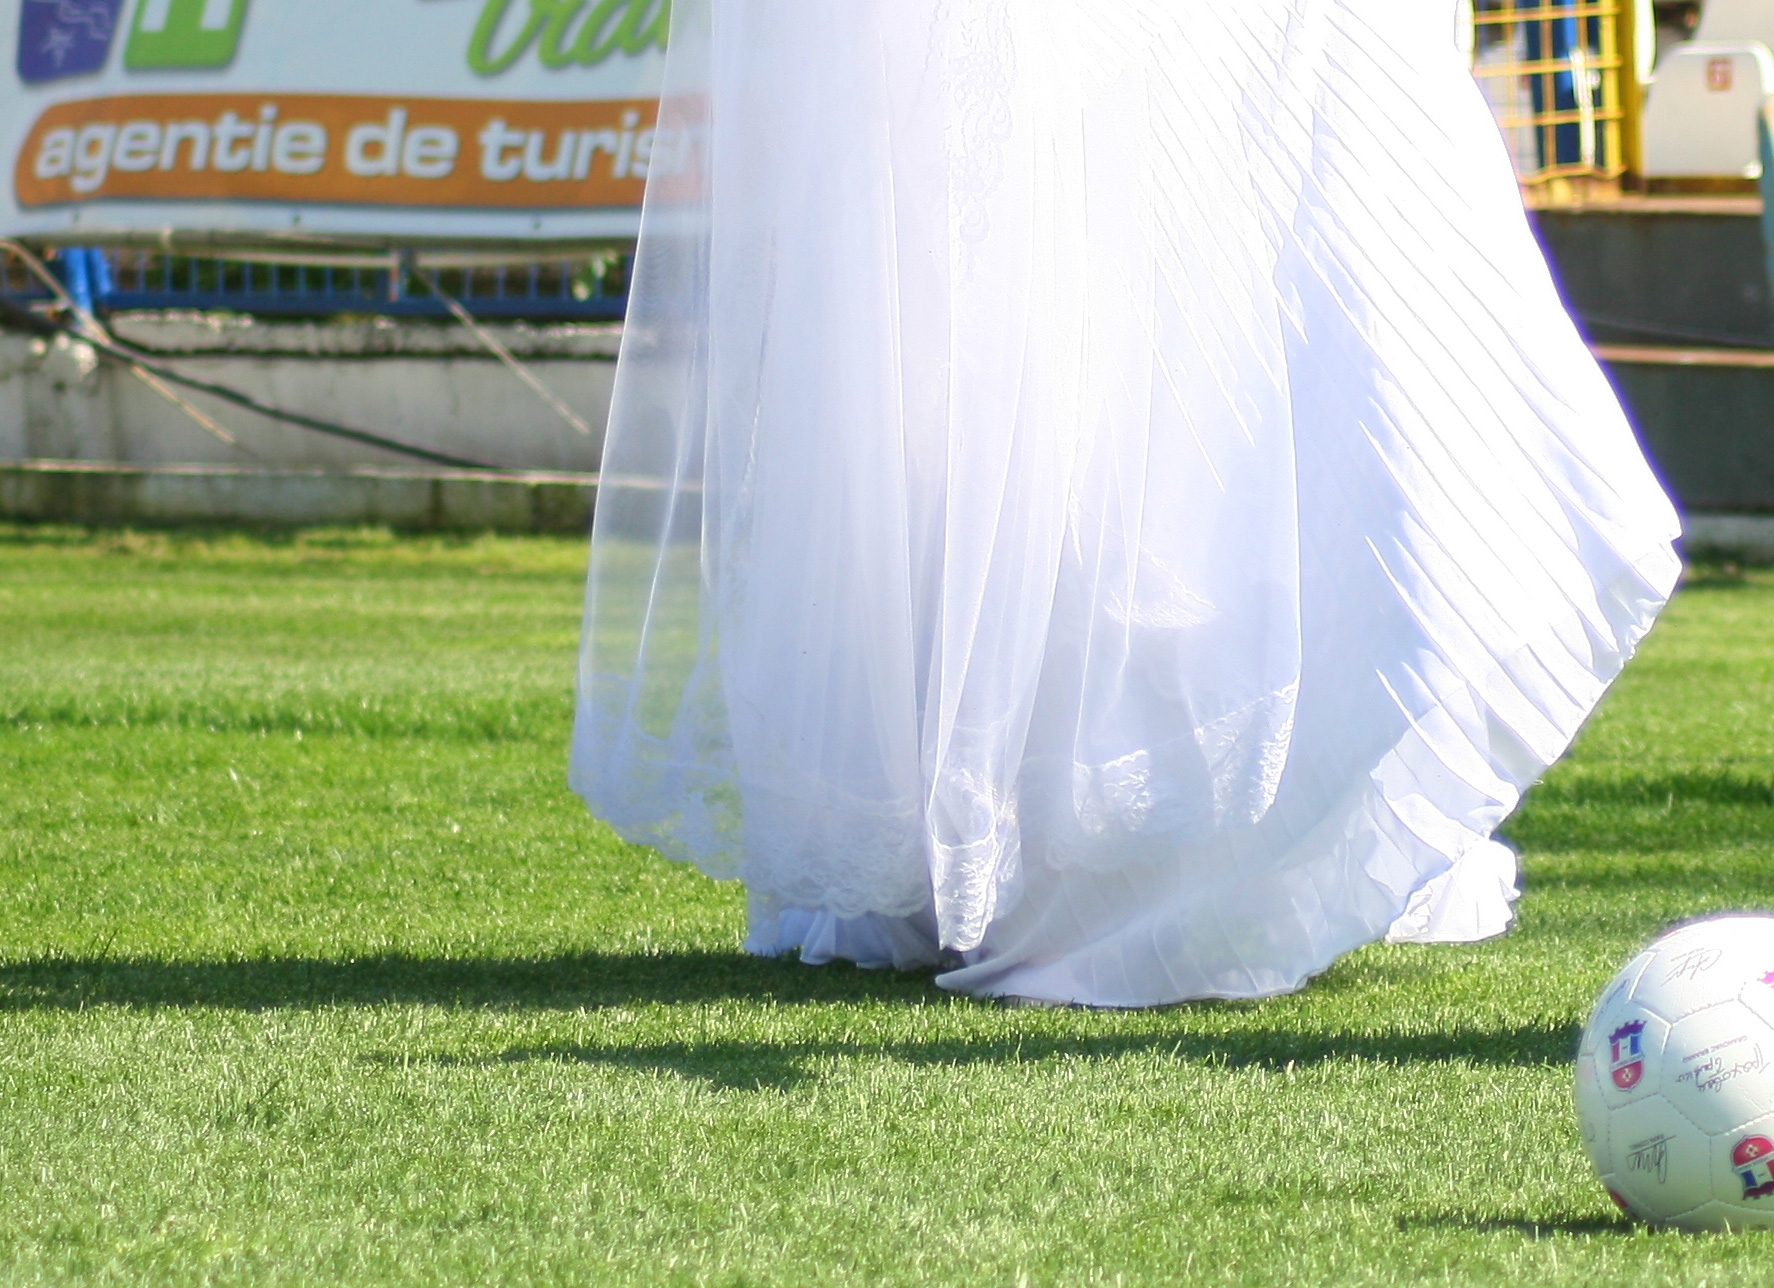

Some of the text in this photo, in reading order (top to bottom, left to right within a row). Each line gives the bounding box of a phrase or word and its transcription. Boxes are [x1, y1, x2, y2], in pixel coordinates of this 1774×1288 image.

[34, 104, 692, 191] agentie de turis
